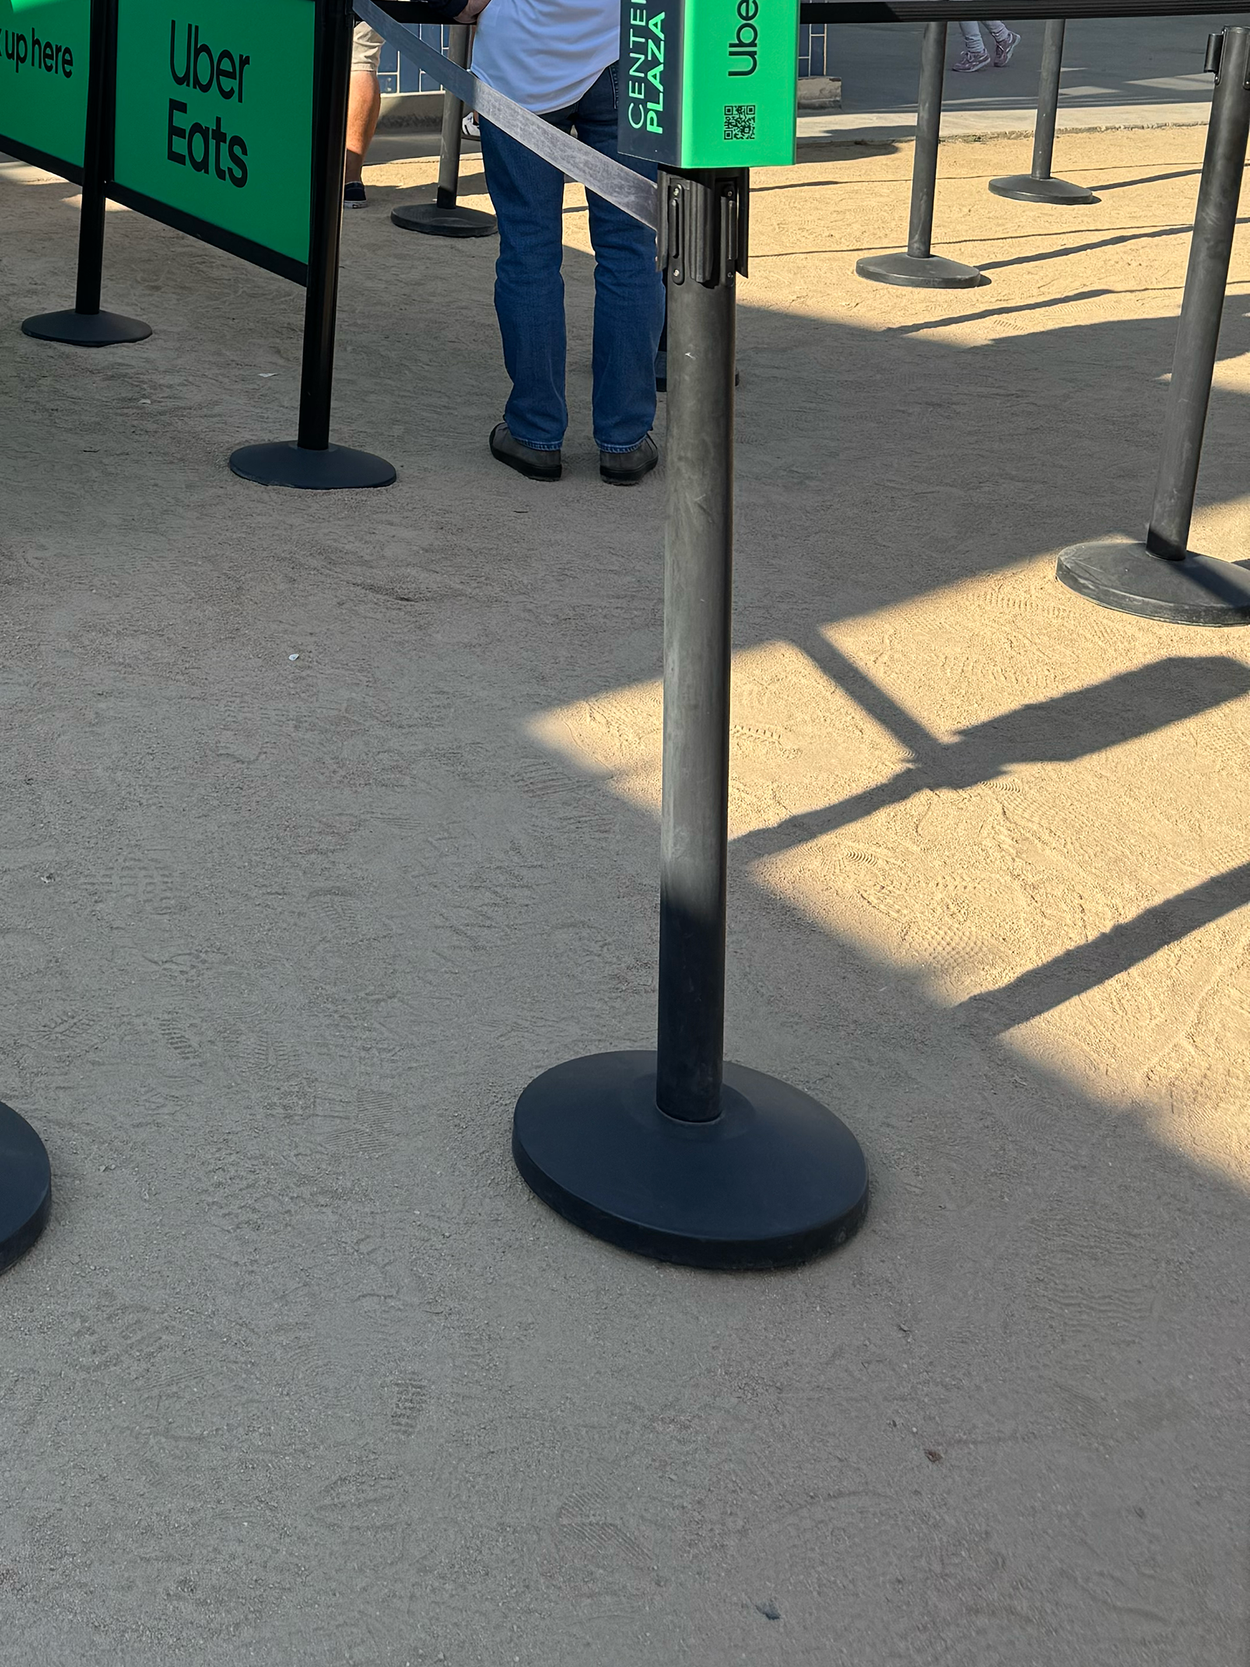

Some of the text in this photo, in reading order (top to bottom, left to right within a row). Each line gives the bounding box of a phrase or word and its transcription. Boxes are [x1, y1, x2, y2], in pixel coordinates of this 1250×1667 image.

[5, 27, 28, 73] up
[31, 27, 74, 79] here
[169, 19, 250, 103] Uber
[647, 11, 666, 134] PLAZA
[167, 98, 248, 188] Eats
